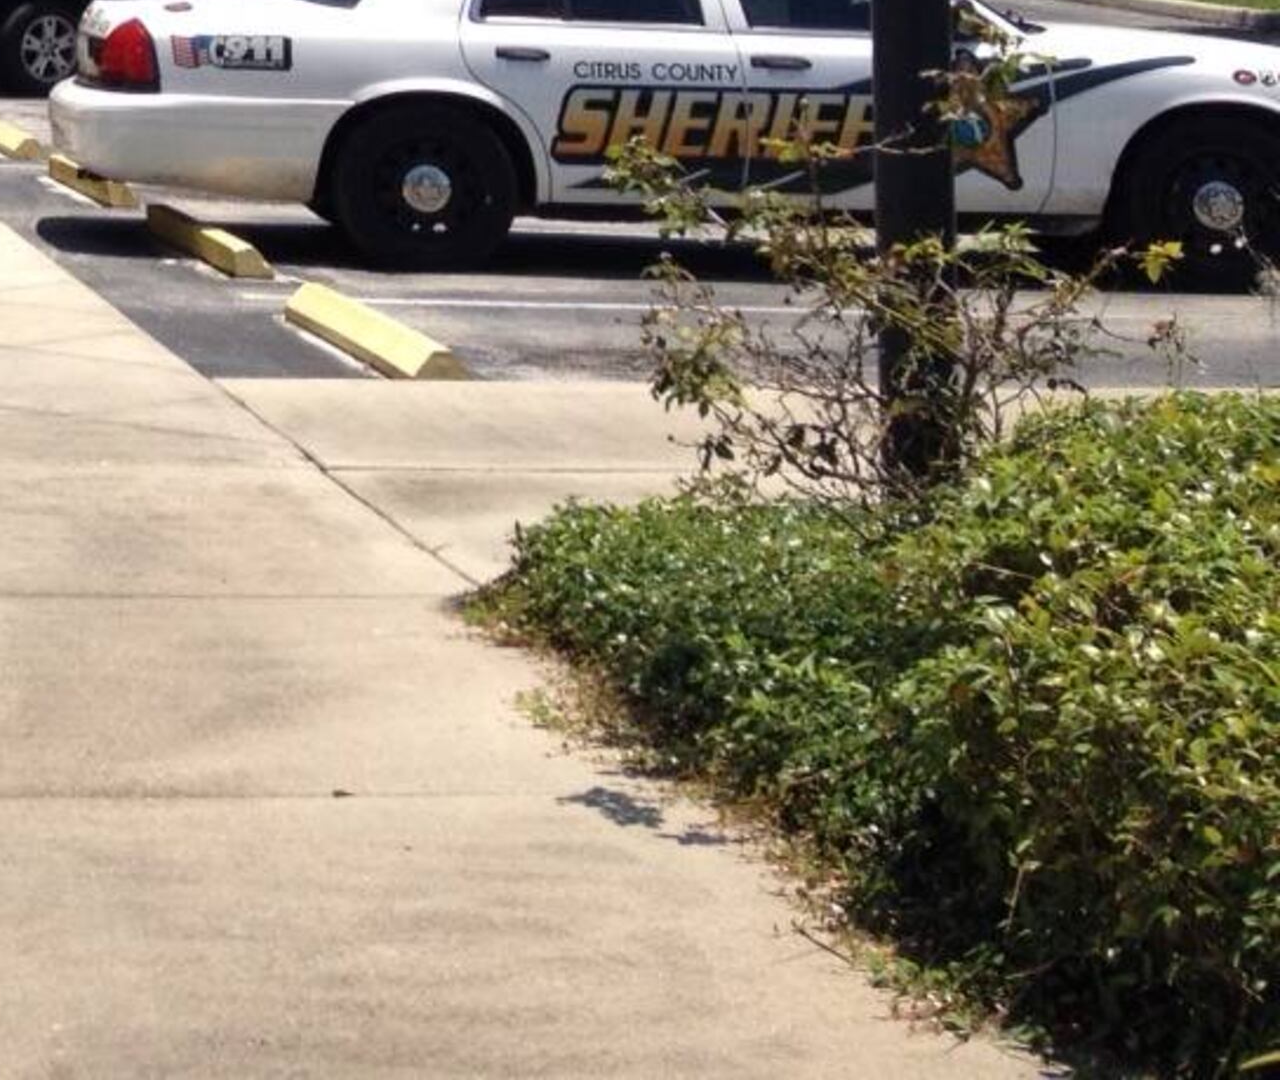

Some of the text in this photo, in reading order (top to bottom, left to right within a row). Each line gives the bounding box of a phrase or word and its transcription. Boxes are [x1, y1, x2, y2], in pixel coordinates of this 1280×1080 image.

[222, 34, 285, 61] 911
[573, 60, 738, 82] CITRUS COUNTY
